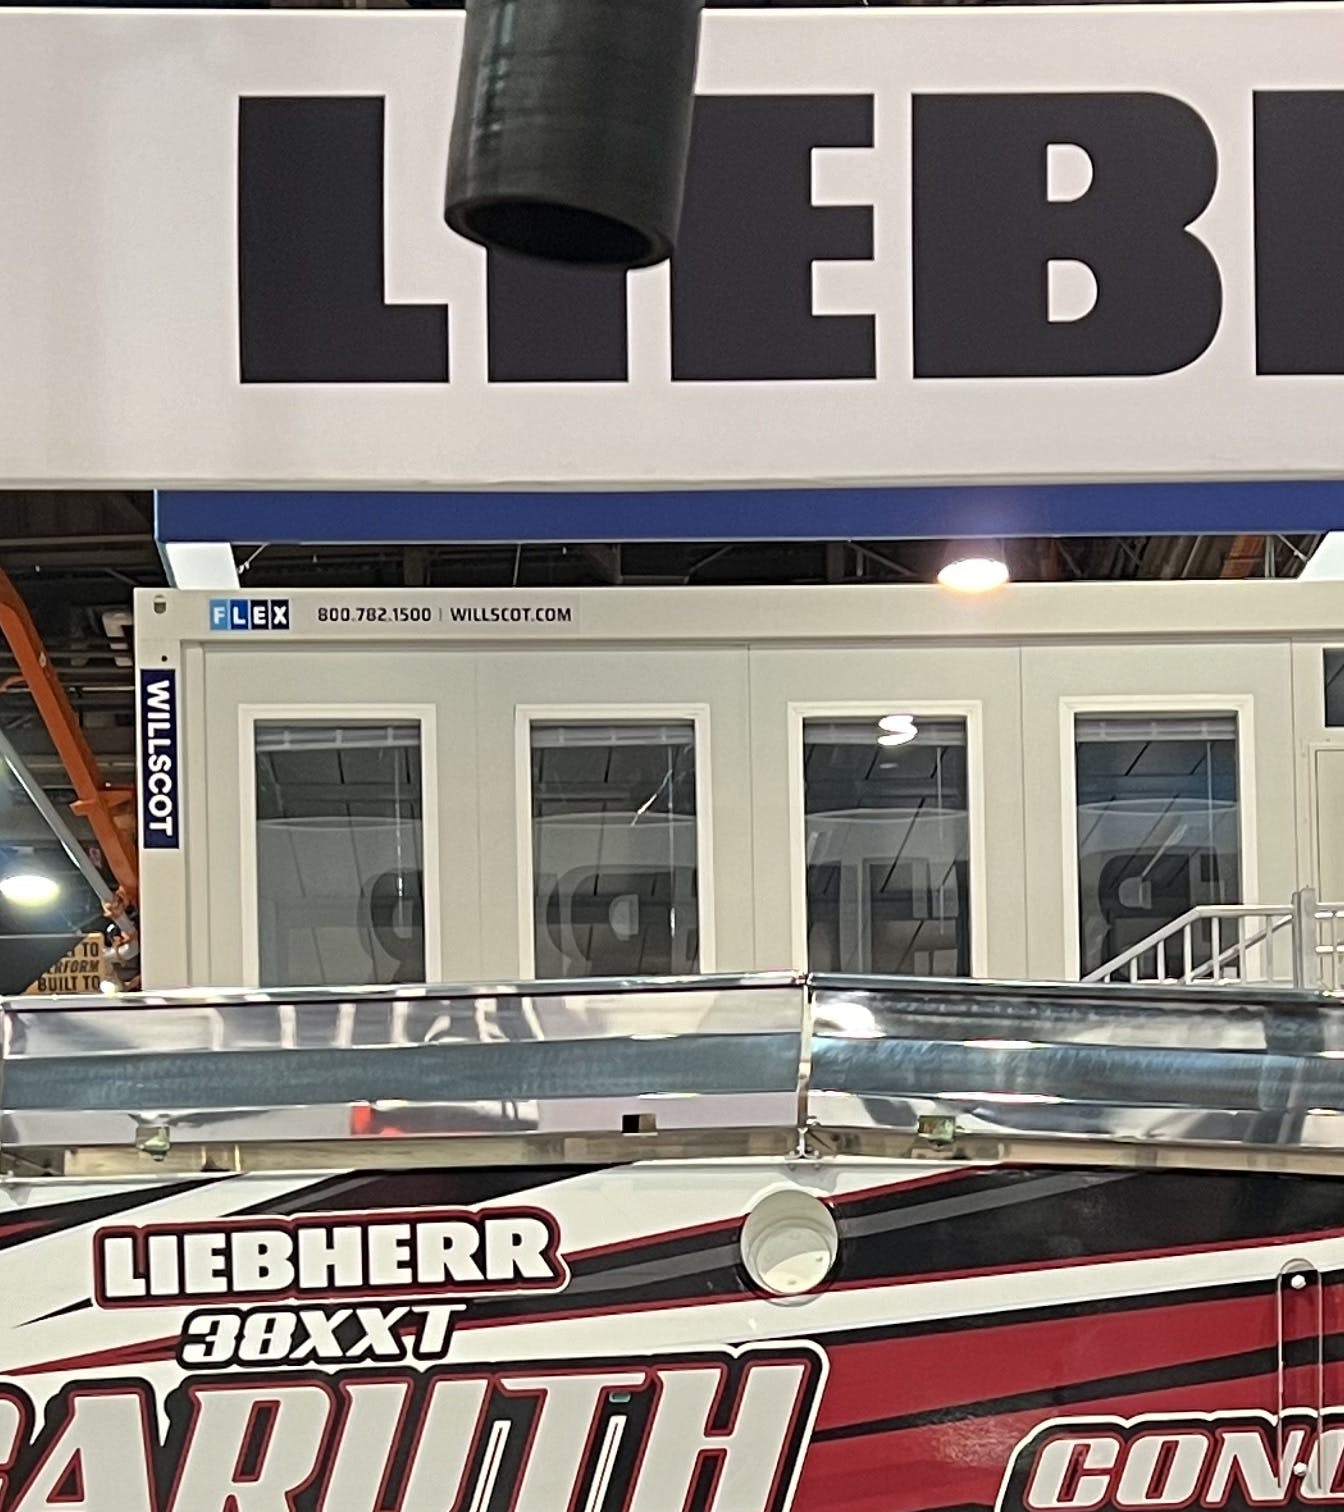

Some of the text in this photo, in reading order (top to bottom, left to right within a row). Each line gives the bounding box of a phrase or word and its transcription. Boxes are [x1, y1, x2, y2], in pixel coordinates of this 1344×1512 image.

[212, 604, 288, 626] FLEX
[317, 607, 572, 622] 800.782.1500 WILLSCOT.COM
[146, 680, 174, 837] WILLSCOT
[38, 976, 77, 992] BUILT
[103, 1217, 555, 1298] LIEBHERR
[181, 1303, 467, 1363] 38XXT
